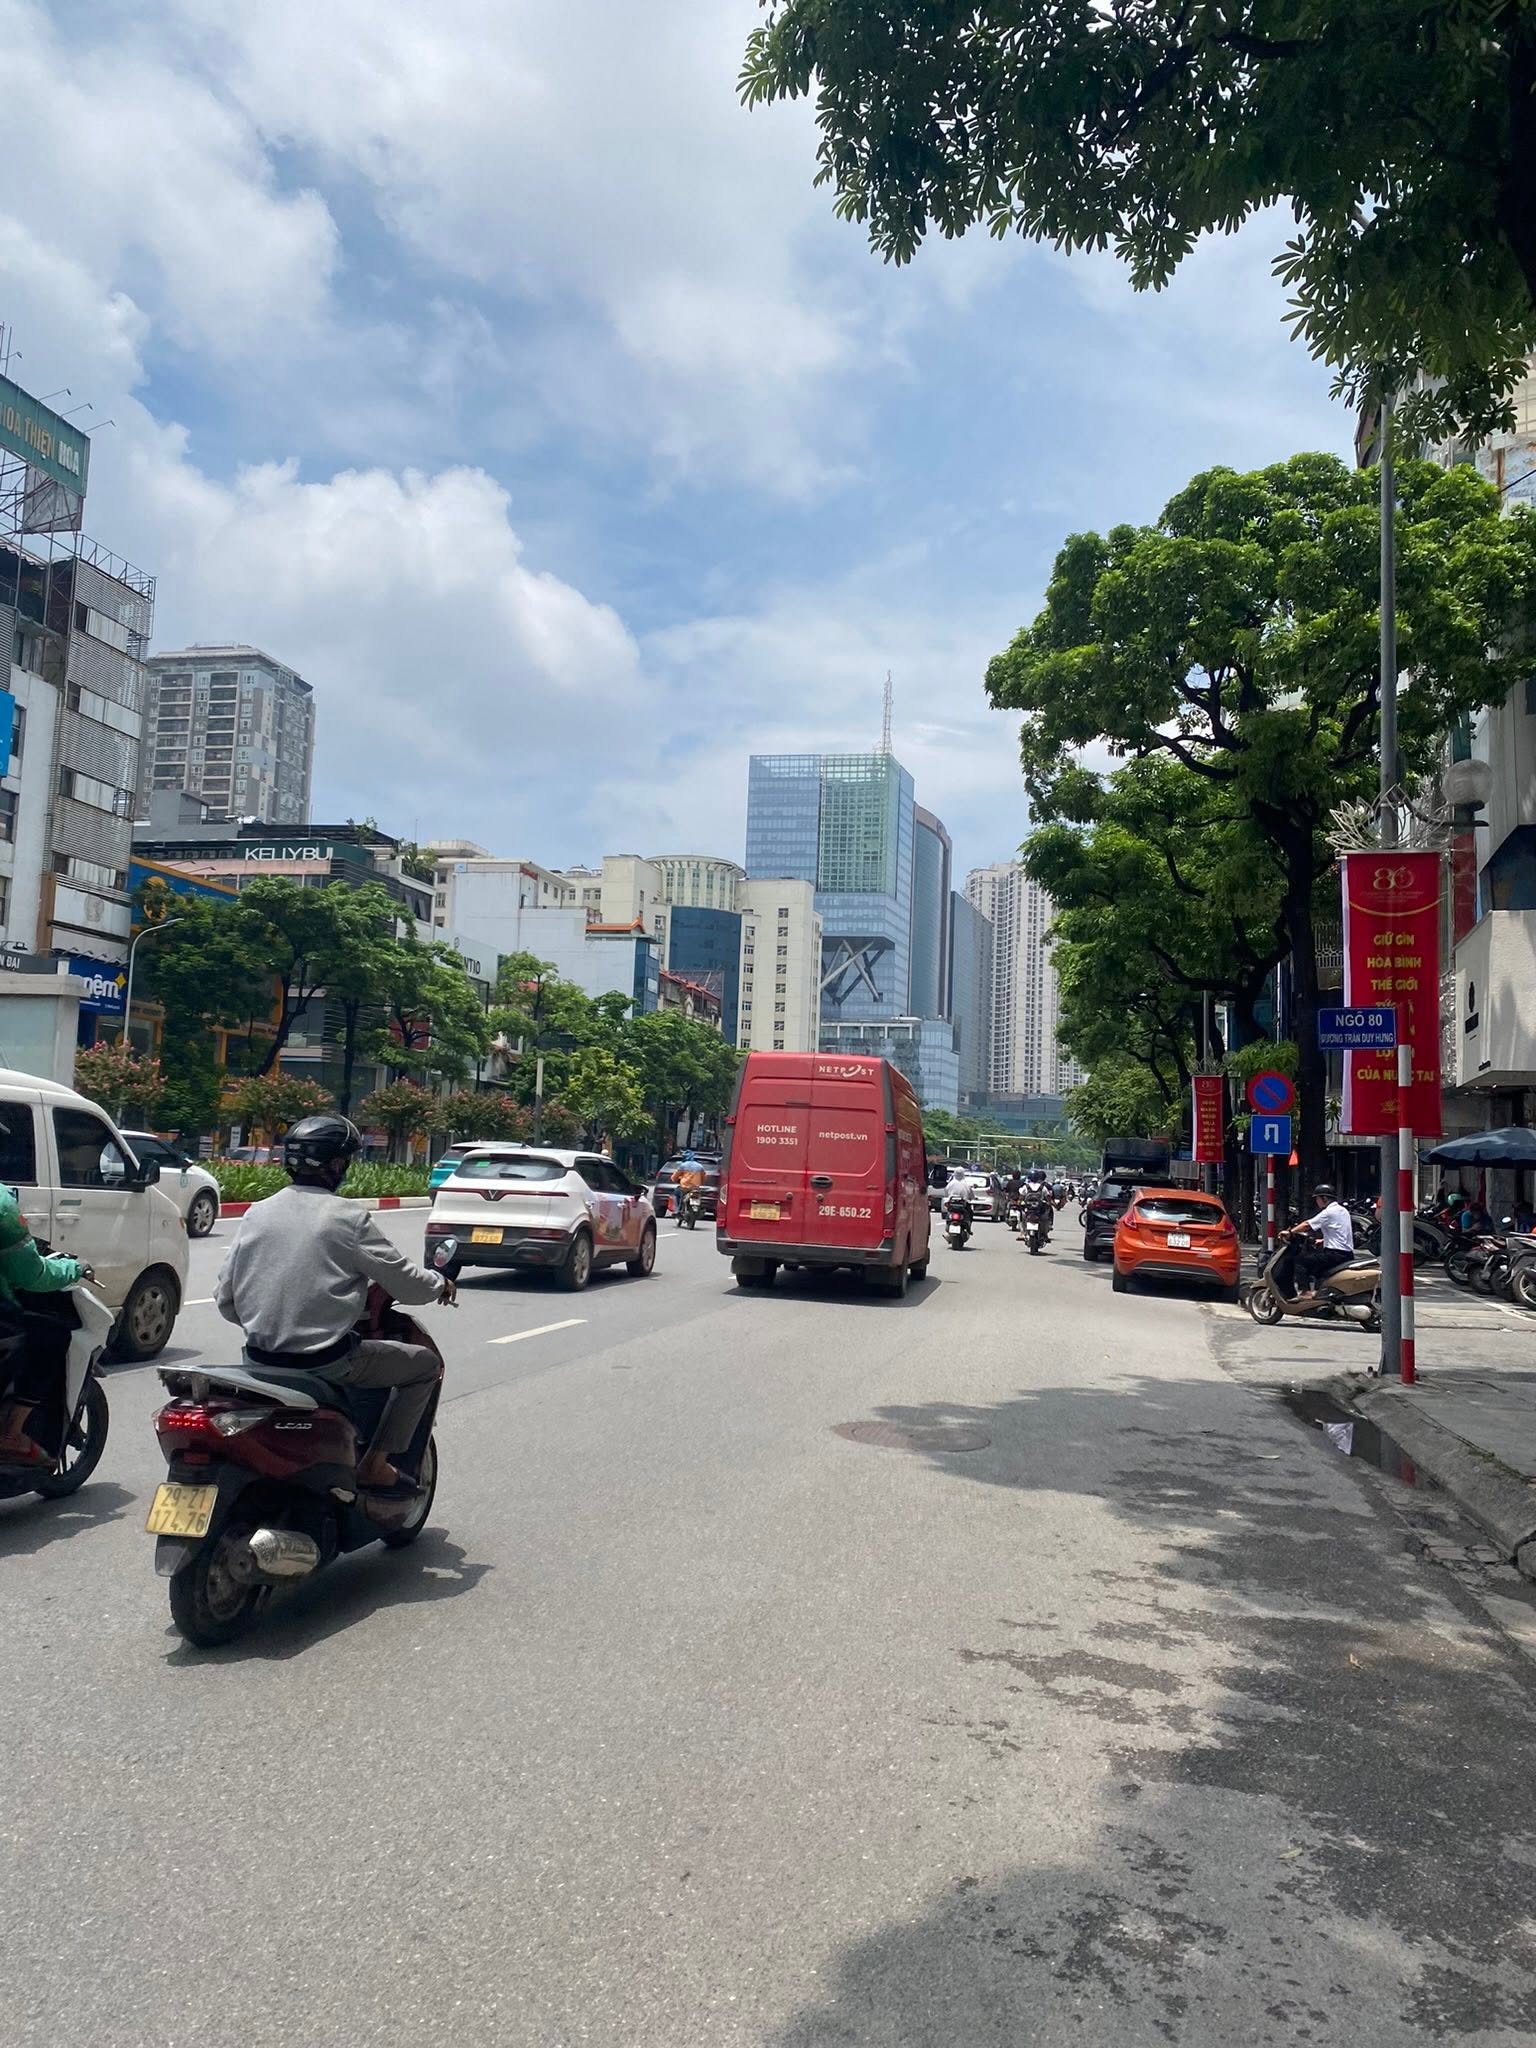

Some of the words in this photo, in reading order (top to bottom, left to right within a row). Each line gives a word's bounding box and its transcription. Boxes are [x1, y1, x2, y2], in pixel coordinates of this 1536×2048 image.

[1367, 953, 1392, 968] HÒA
[1394, 953, 1422, 968] BÌNH
[1370, 976, 1393, 991] THẾ
[1335, 1011, 1364, 1027] NGÕ
[1368, 1014, 1383, 1027] 80
[1362, 1033, 1374, 1043] DUY
[1357, 1065, 1380, 1080] CỦA
[757, 1124, 798, 1134] HOTLINE
[819, 1131, 868, 1141] netpost.vn
[756, 1136, 777, 1145] 1900
[779, 1137, 798, 1145] 3351
[153, 1509, 206, 1533] 174.76
